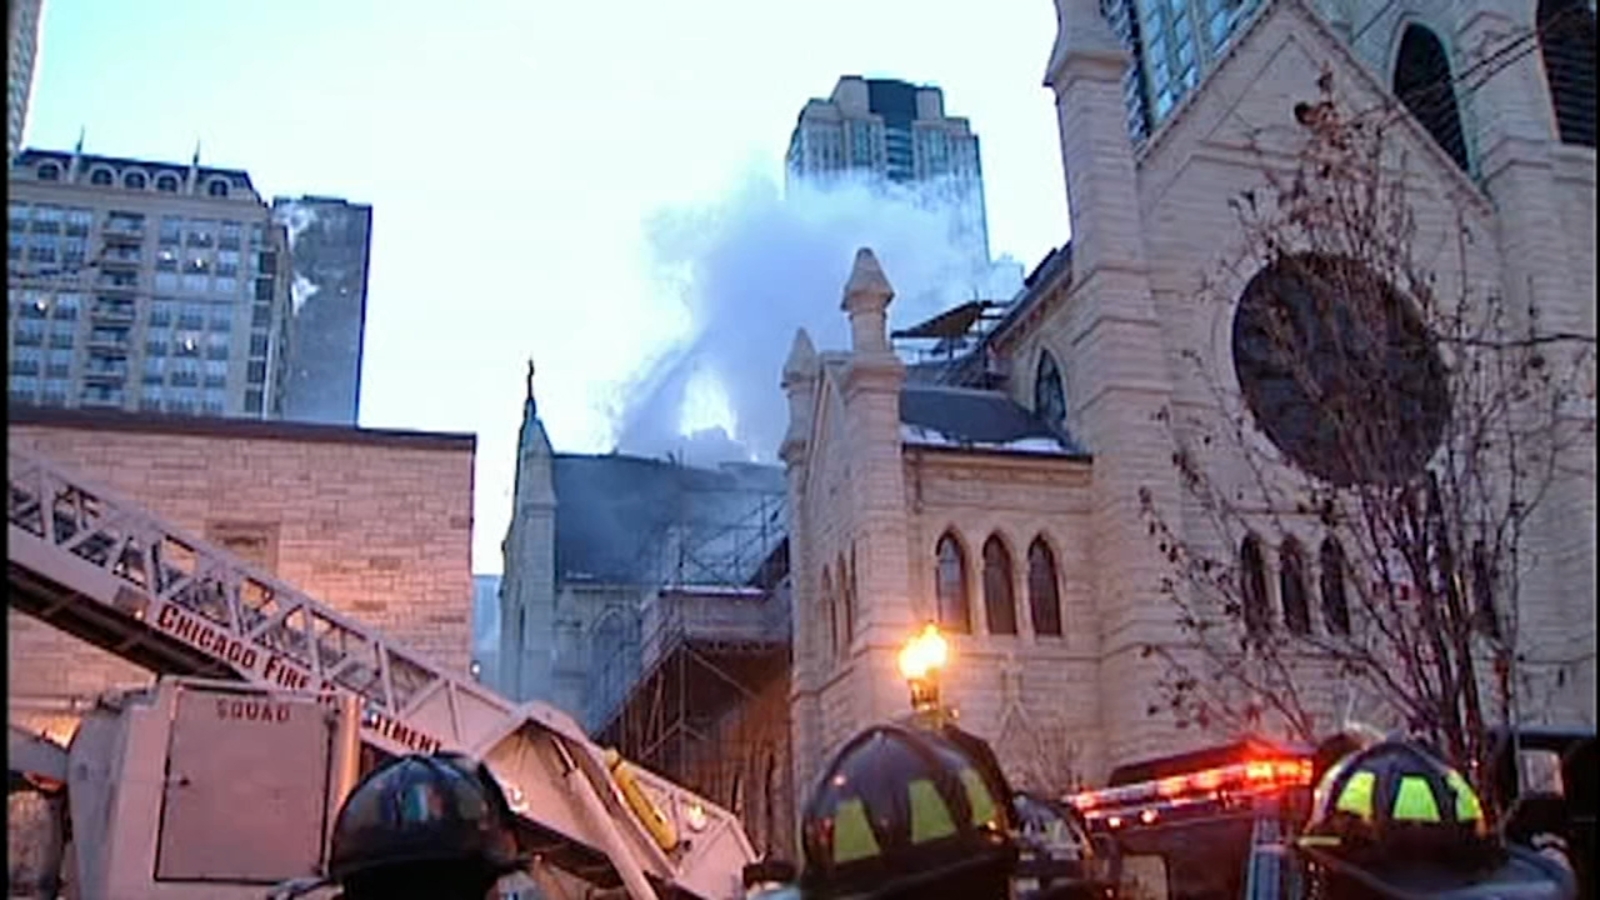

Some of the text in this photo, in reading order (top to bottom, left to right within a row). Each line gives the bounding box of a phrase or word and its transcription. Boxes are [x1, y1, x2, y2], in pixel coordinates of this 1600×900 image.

[158, 604, 257, 669] CHICAGO
[264, 655, 310, 690] FIRE
[216, 699, 290, 721] SQUAD
